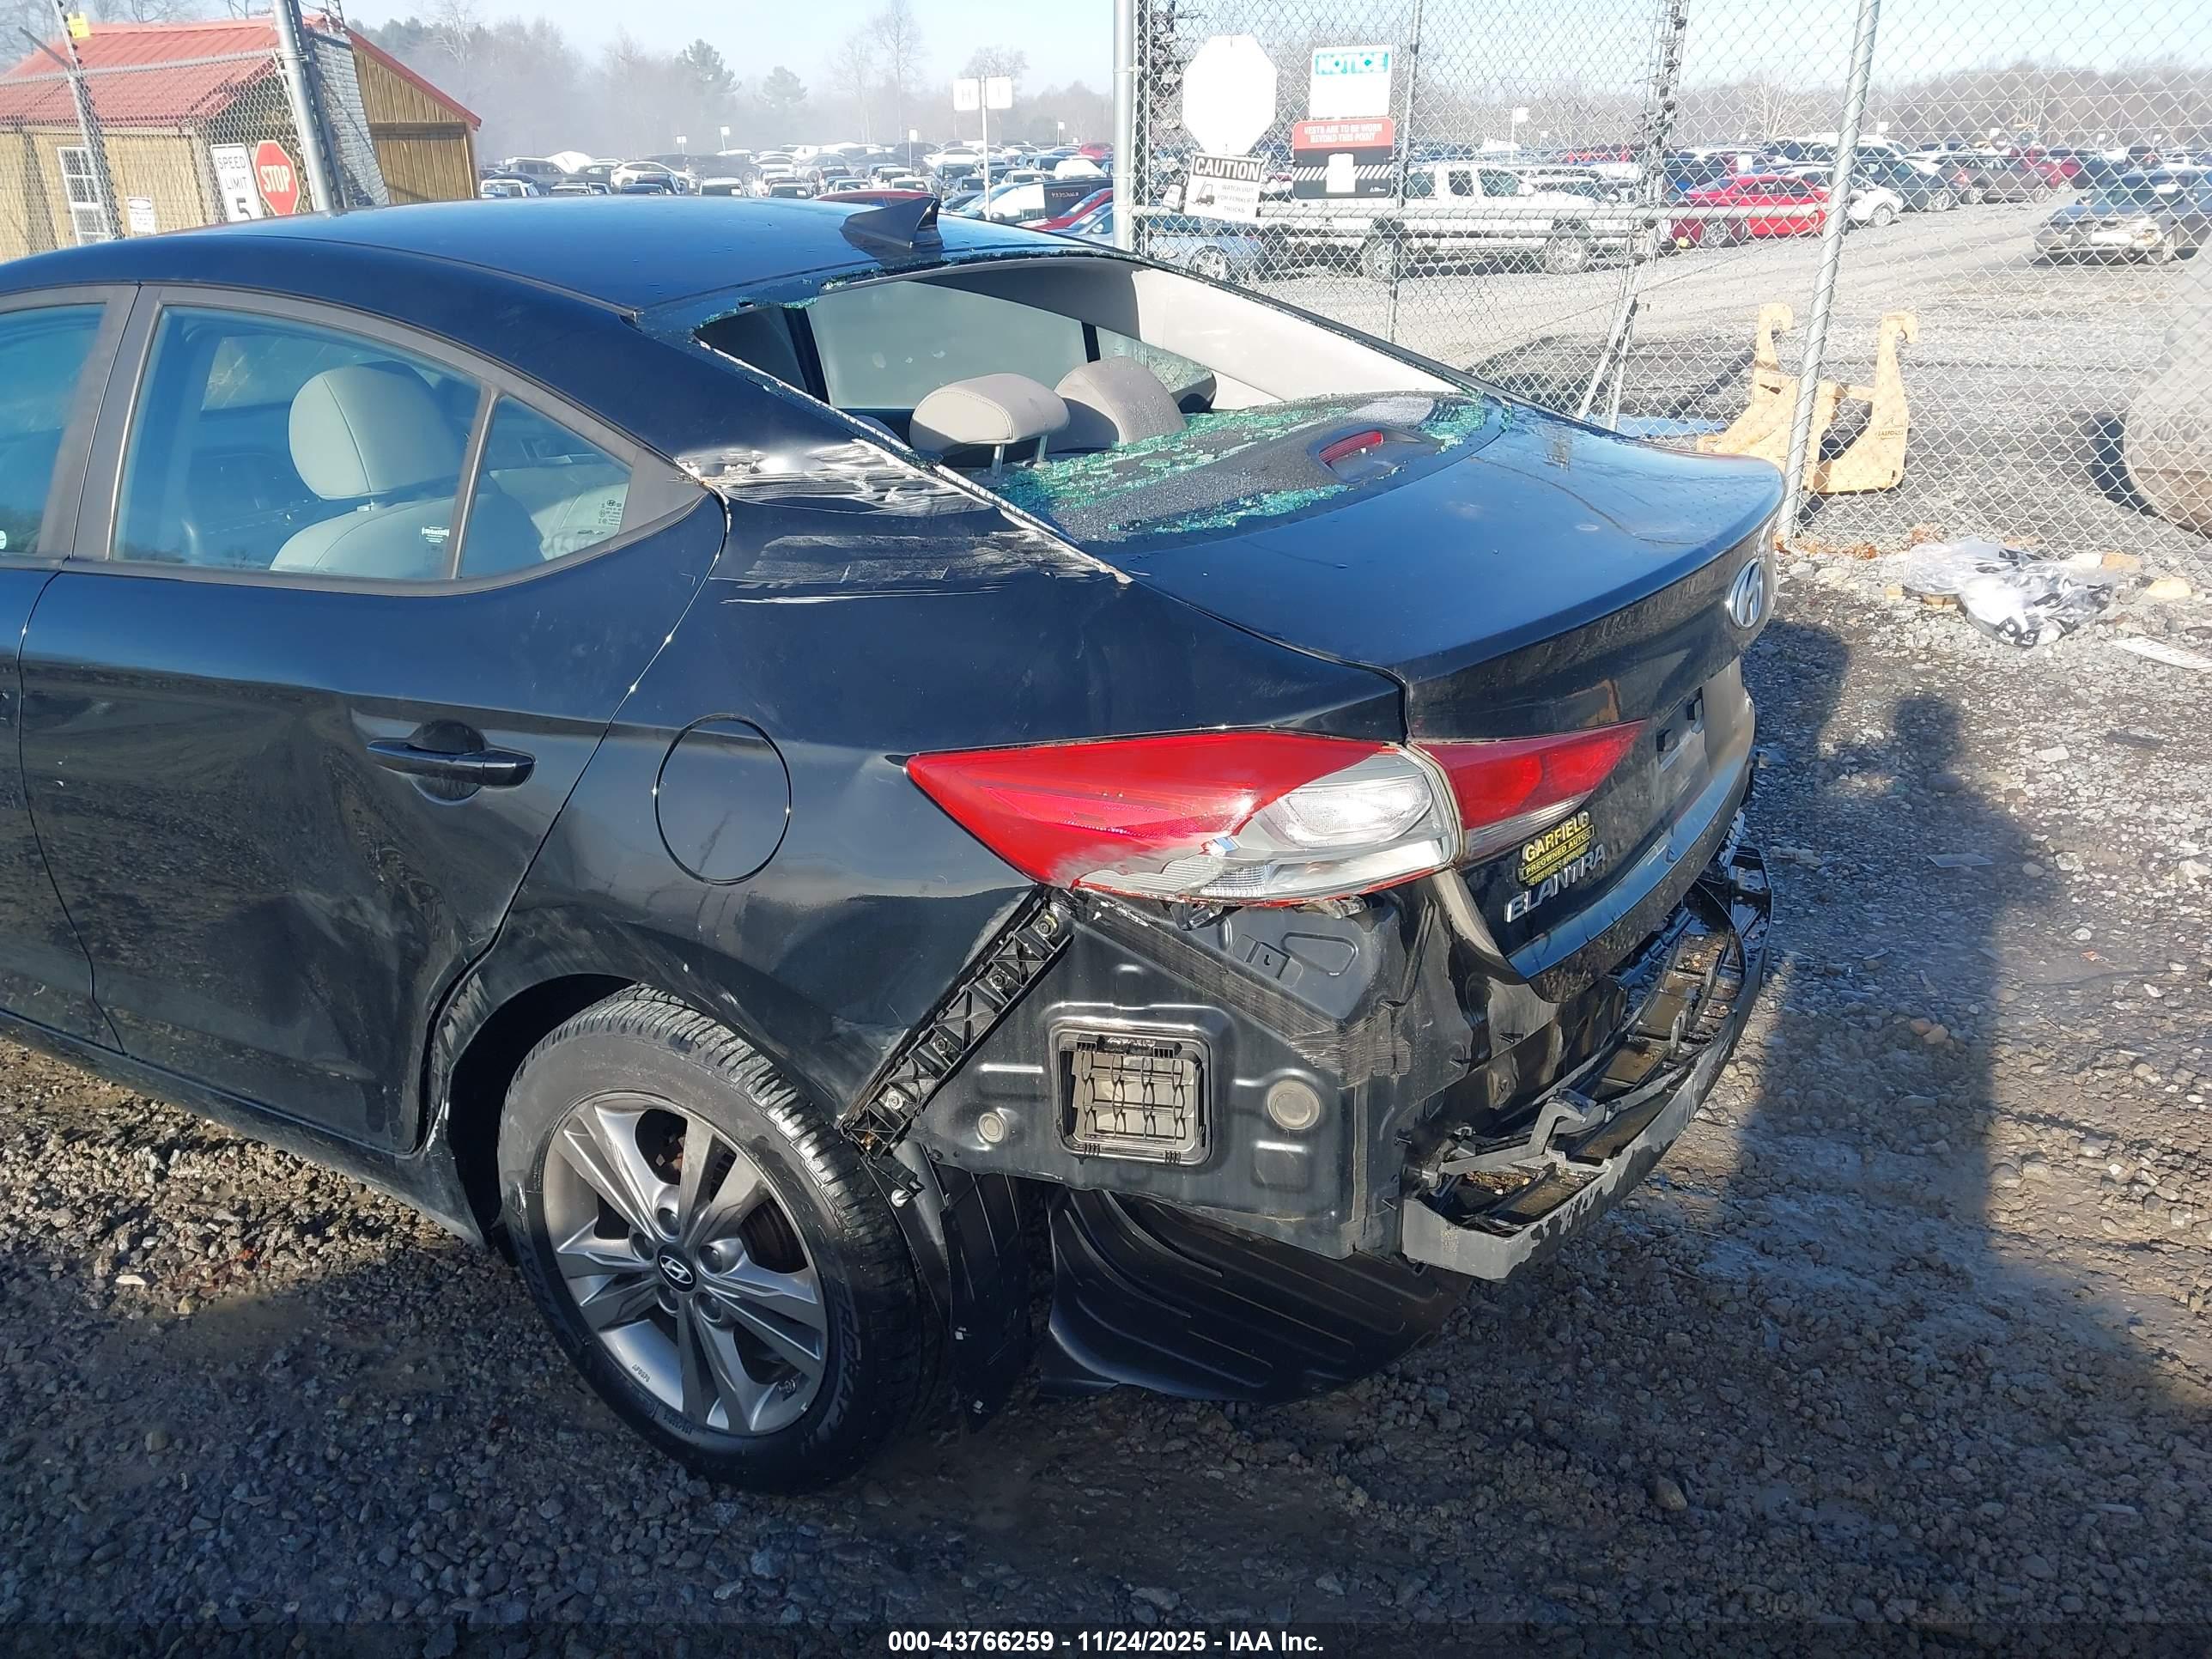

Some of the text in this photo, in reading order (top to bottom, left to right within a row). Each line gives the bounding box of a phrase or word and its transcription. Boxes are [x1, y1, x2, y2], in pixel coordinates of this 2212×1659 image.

[1317, 53, 1385, 74] NOTICE
[1310, 132, 1375, 143] BEYOND THIS POINT
[1361, 123, 1382, 132] WORN
[217, 155, 246, 169] SPEED
[1194, 157, 1260, 181] CAUTION
[224, 177, 246, 190] LIMIT
[259, 164, 291, 192] STOP
[235, 198, 252, 220] 5
[1522, 810, 1589, 862] GARFIELD
[1526, 830, 1590, 875] PREOWNED AUTOS
[1504, 844, 1607, 923] ELANTRA
